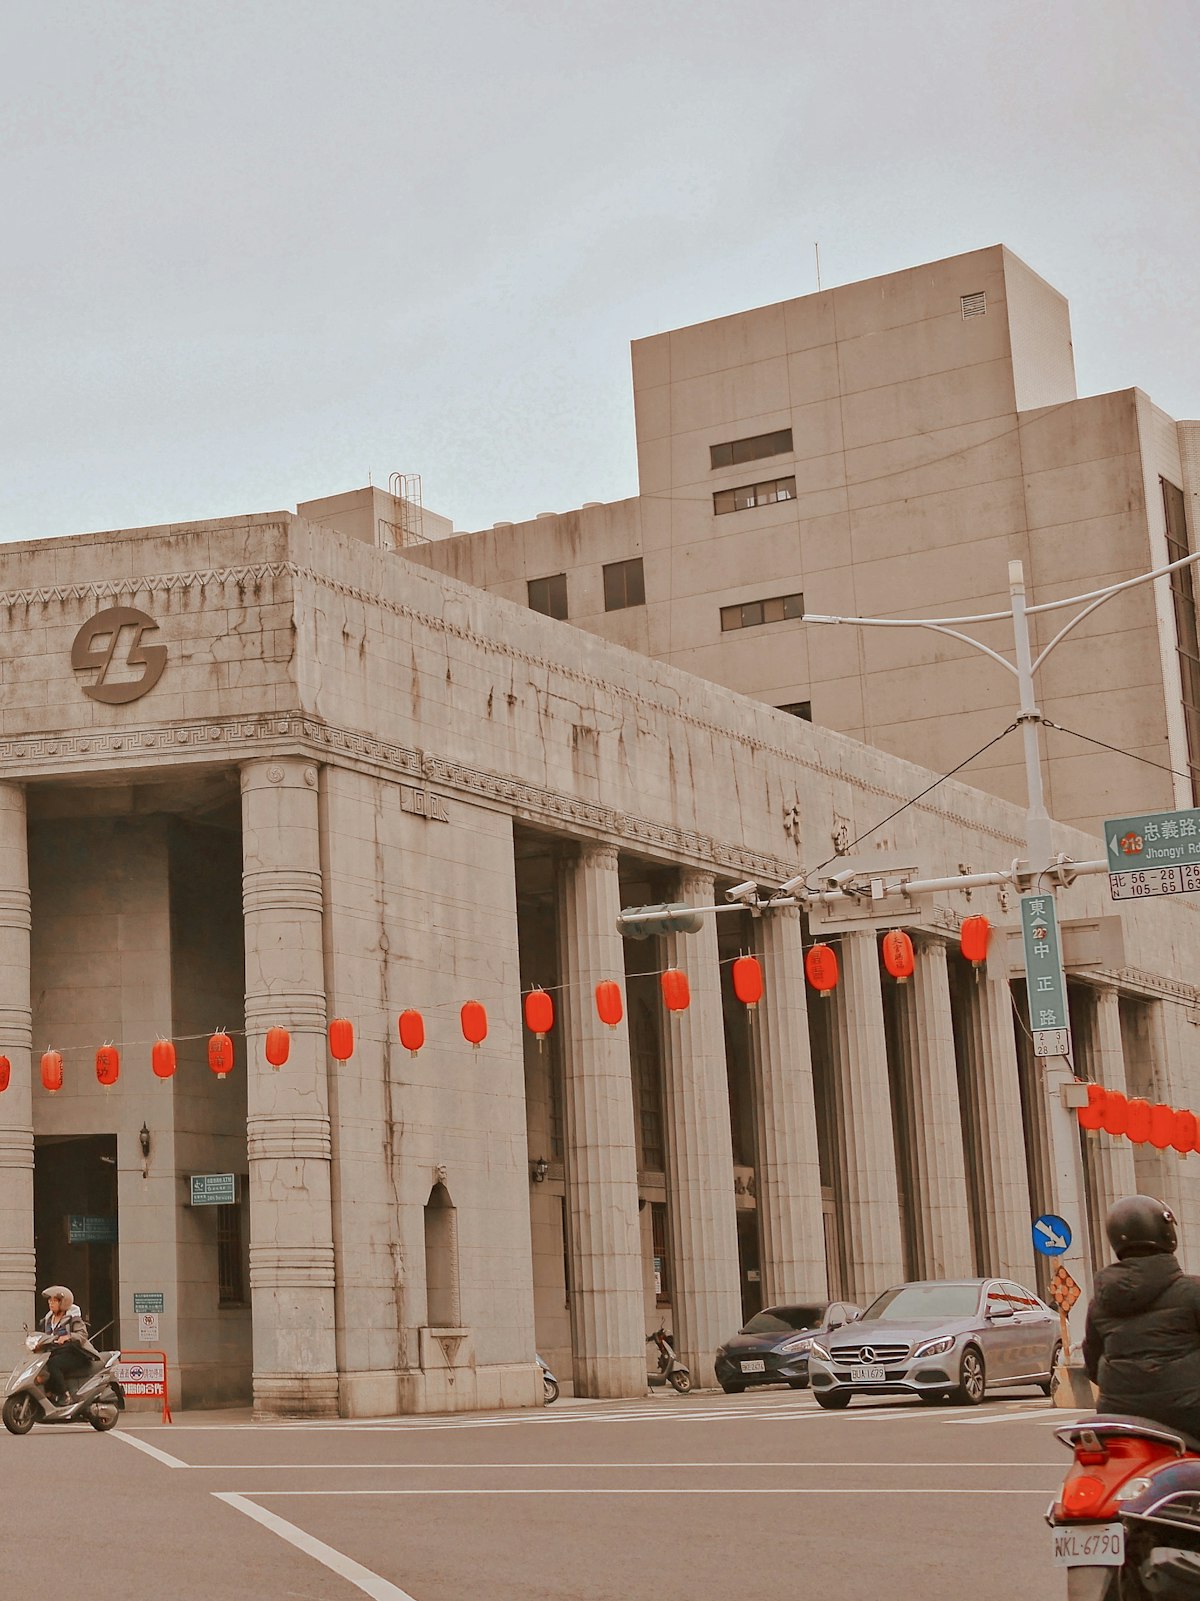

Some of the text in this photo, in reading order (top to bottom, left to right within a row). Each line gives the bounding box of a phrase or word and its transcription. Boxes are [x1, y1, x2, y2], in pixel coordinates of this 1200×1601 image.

[1144, 818, 1200, 842] 忠義路
[1146, 844, 1184, 859] Jhongyi
[1112, 875, 1126, 888] 北
[1131, 869, 1175, 884] 56-28
[1113, 889, 1120, 898] N
[1130, 881, 1176, 896] 105-65
[1028, 899, 1046, 916] 東
[1033, 941, 1057, 1026] 中正路
